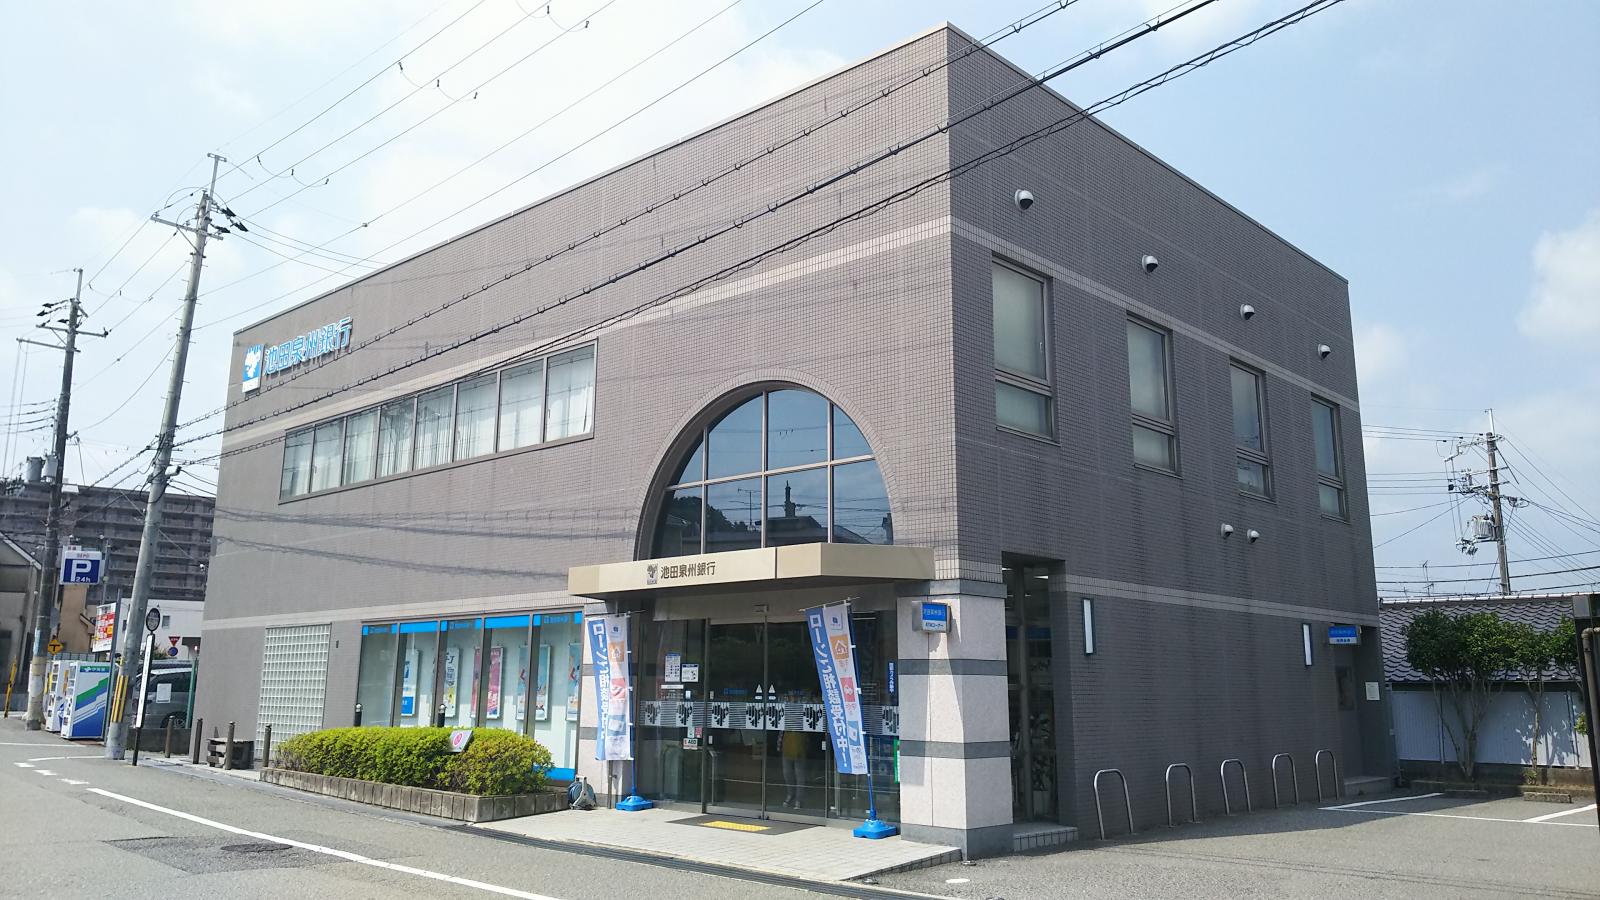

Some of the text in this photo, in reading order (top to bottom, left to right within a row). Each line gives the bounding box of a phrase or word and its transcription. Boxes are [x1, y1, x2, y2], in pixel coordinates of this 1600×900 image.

[264, 316, 353, 375] 池田泉州銀行
[70, 559, 92, 582] P
[660, 561, 716, 579] 池田泉州銀行
